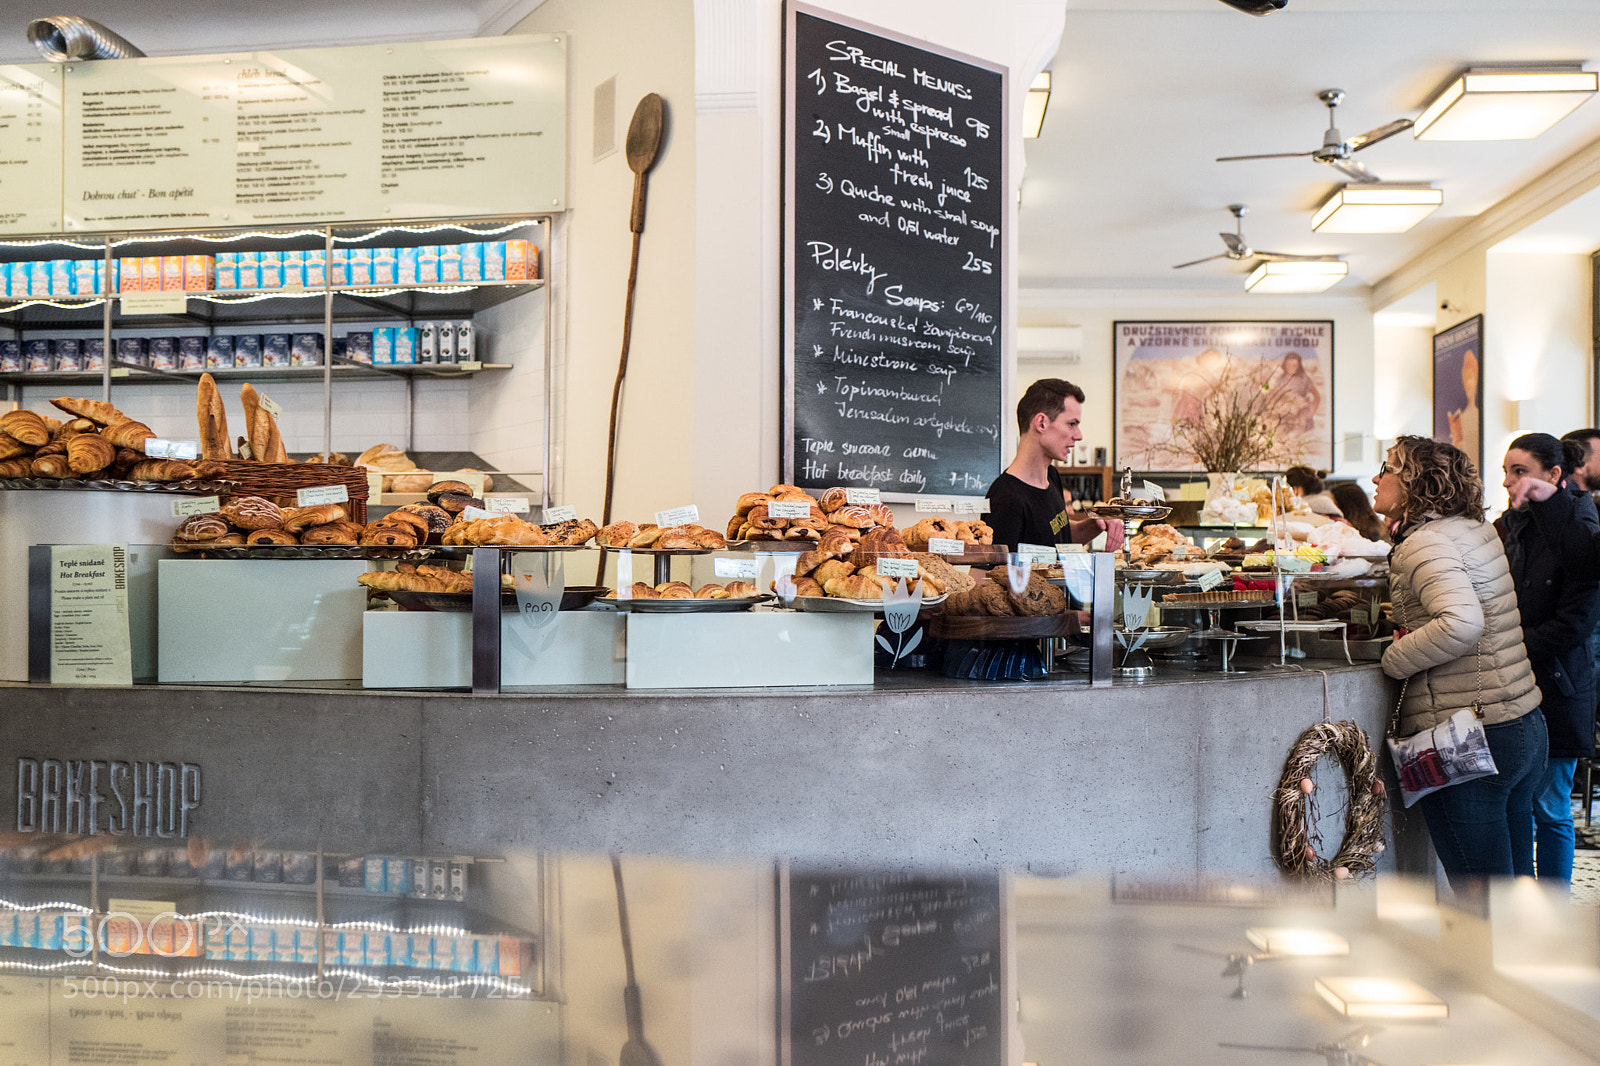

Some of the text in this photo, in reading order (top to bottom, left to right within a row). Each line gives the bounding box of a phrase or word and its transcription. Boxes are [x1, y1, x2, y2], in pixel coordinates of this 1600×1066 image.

[826, 40, 973, 100] SPECIAL MENUS:
[807, 68, 991, 140] 1) Bagel & spread 95
[812, 119, 929, 169] 2) Muffin with
[872, 108, 968, 150] with espresso
[148, 188, 166, 198] Bon
[889, 162, 991, 207] fresh juice 125
[815, 172, 1000, 249] 3) Quiche with small soup
[858, 211, 891, 228] and
[923, 226, 960, 246] water
[806, 241, 993, 296] Polévky 255
[884, 284, 946, 312] Soups:
[829, 322, 876, 342] French
[801, 458, 830, 480] Hot
[838, 461, 894, 488] breakfast
[899, 468, 927, 493] daily
[74, 571, 105, 579] Breakfast
[113, 546, 126, 590] BAKESHOP
[18, 757, 201, 839] BAKESHOP
